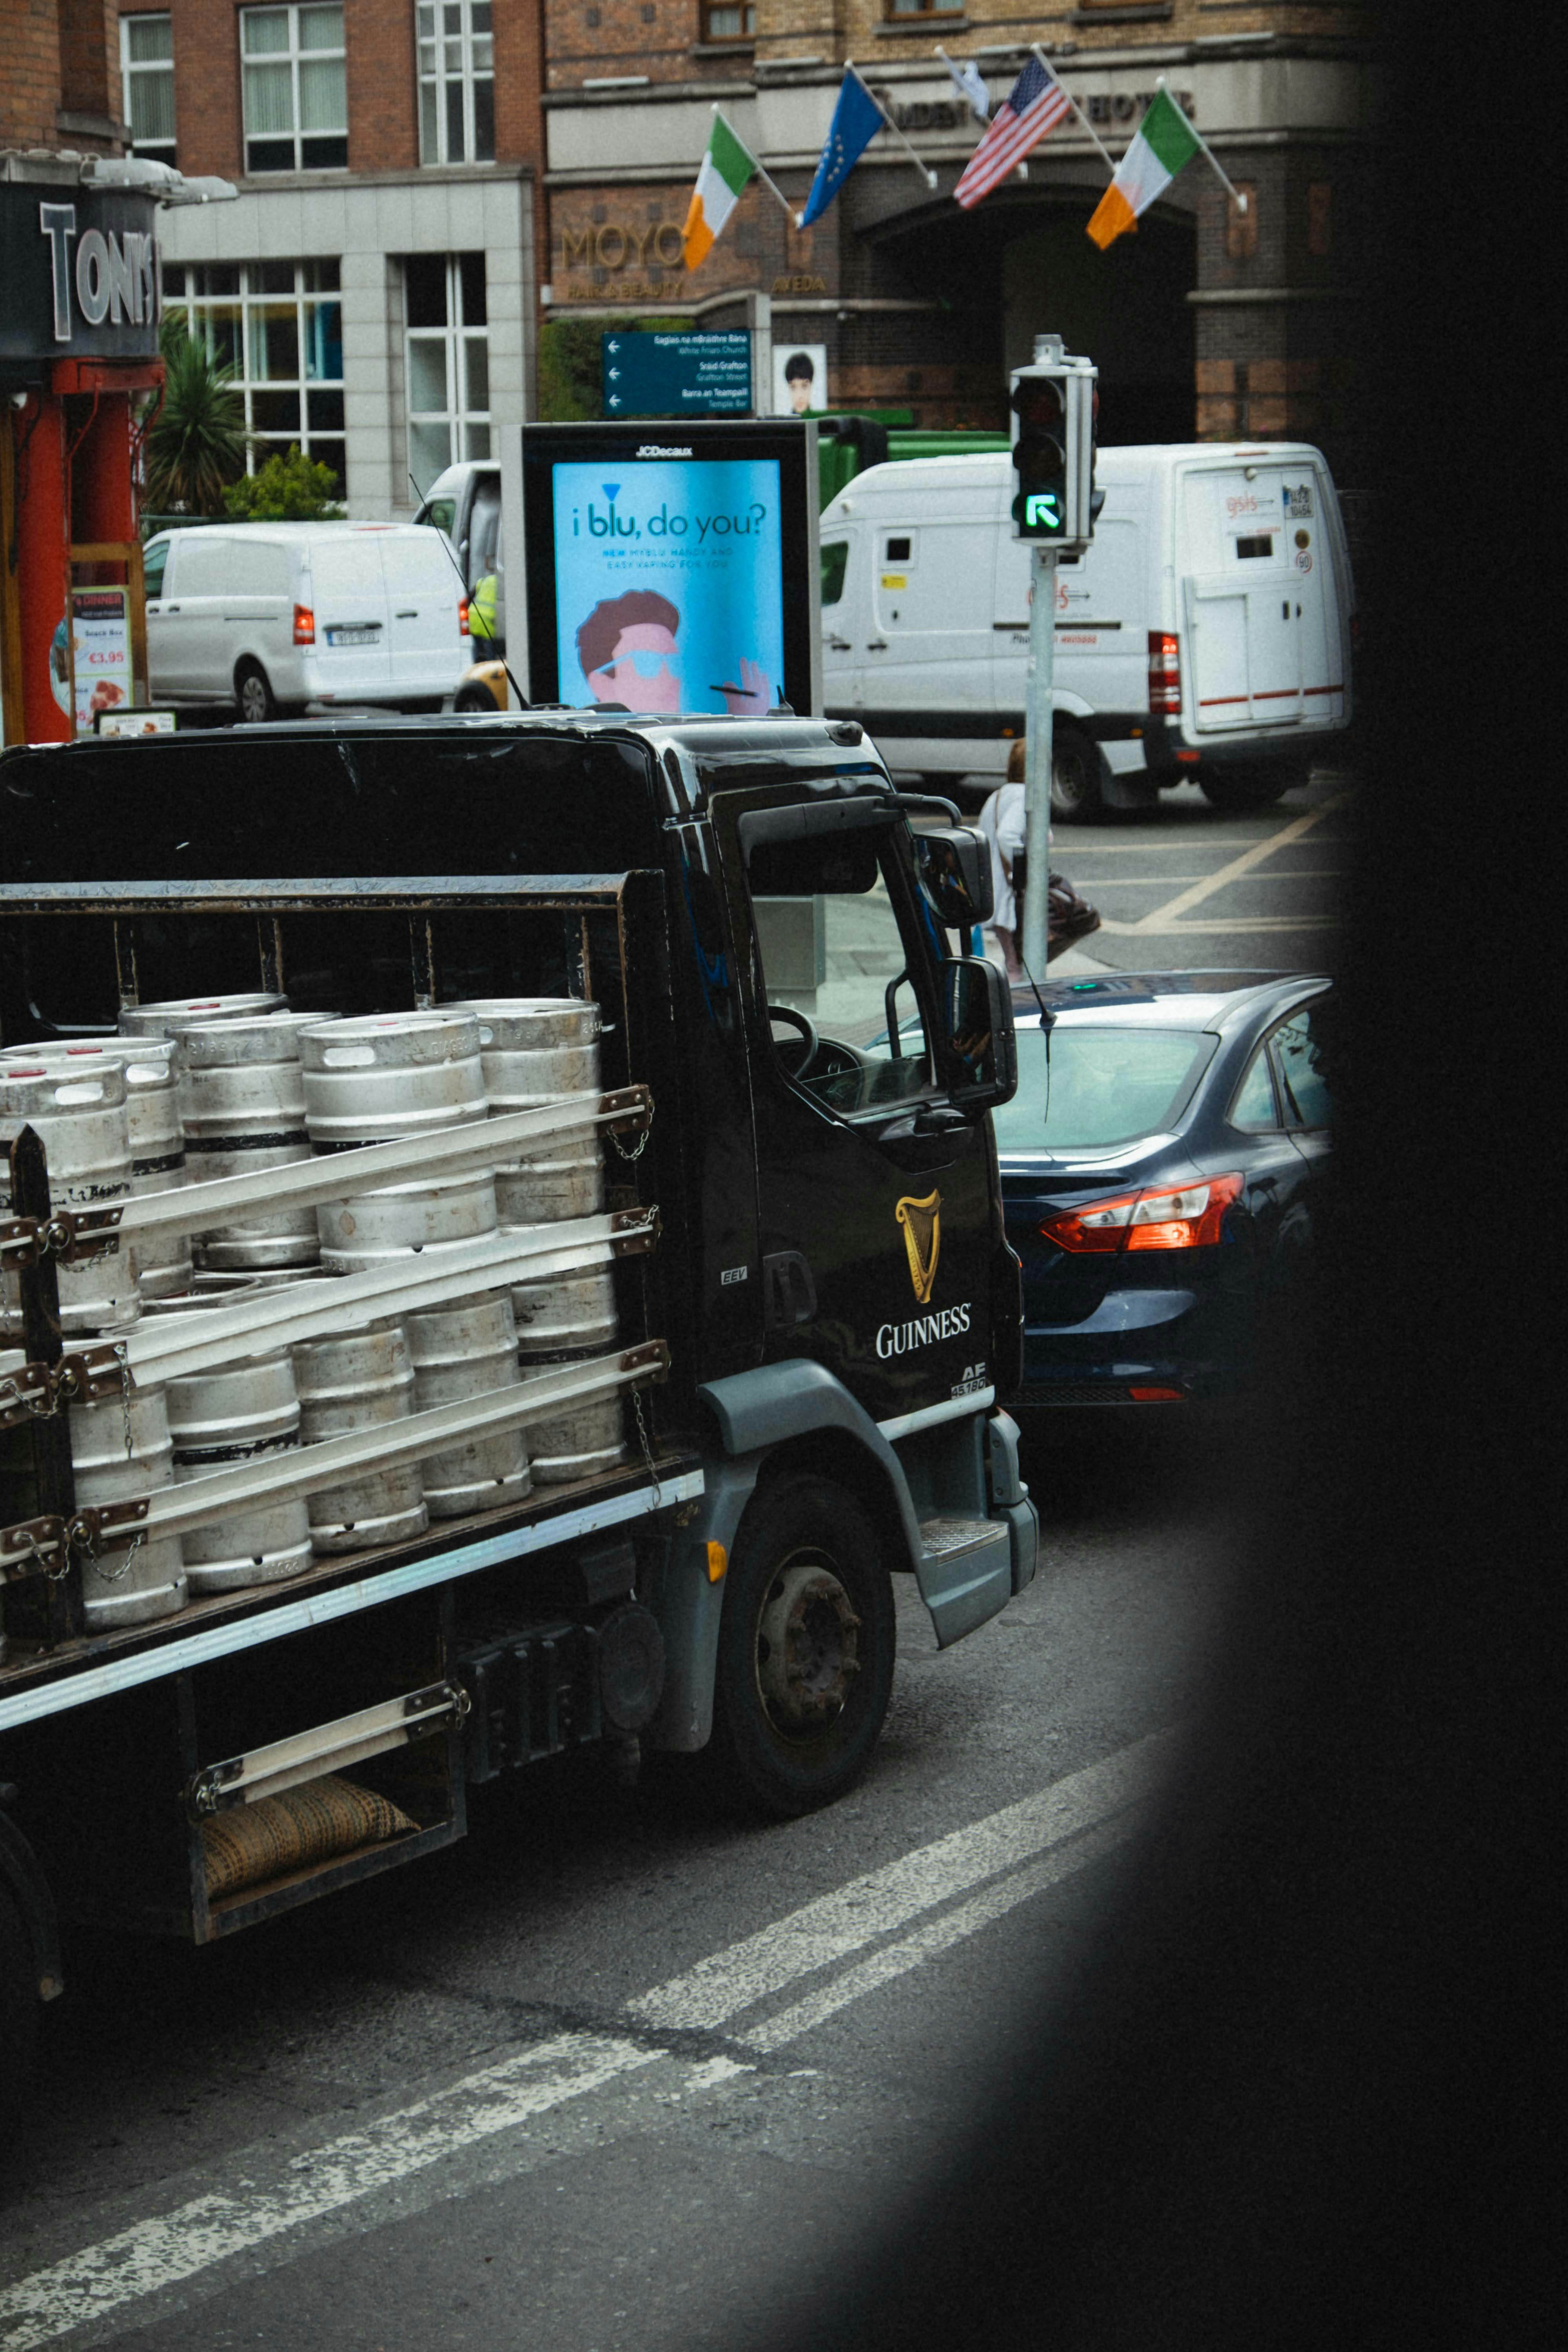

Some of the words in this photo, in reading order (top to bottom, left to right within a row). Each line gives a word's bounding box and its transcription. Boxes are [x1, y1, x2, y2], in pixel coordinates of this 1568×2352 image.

[562, 222, 686, 269] MOYO
[569, 285, 603, 298] HAIR
[621, 282, 684, 297] BEAUTY
[772, 277, 826, 292] AVEDA
[719, 361, 748, 370] Grafton
[696, 373, 724, 381] Grafton
[709, 400, 734, 409] Temple
[735, 399, 747, 407] Bar
[636, 445, 693, 457] JCDecaux
[573, 508, 579, 536] i
[588, 503, 641, 540] blu,
[648, 503, 688, 536] do
[696, 503, 766, 544] you?
[607, 561, 633, 569] EASY
[636, 560, 676, 569] VAPING
[679, 559, 703, 568] FOR
[83, 592, 122, 605] DINNER
[723, 1268, 746, 1283] EEV
[876, 1303, 971, 1359] GUINNESS
[962, 1362, 985, 1382] AF
